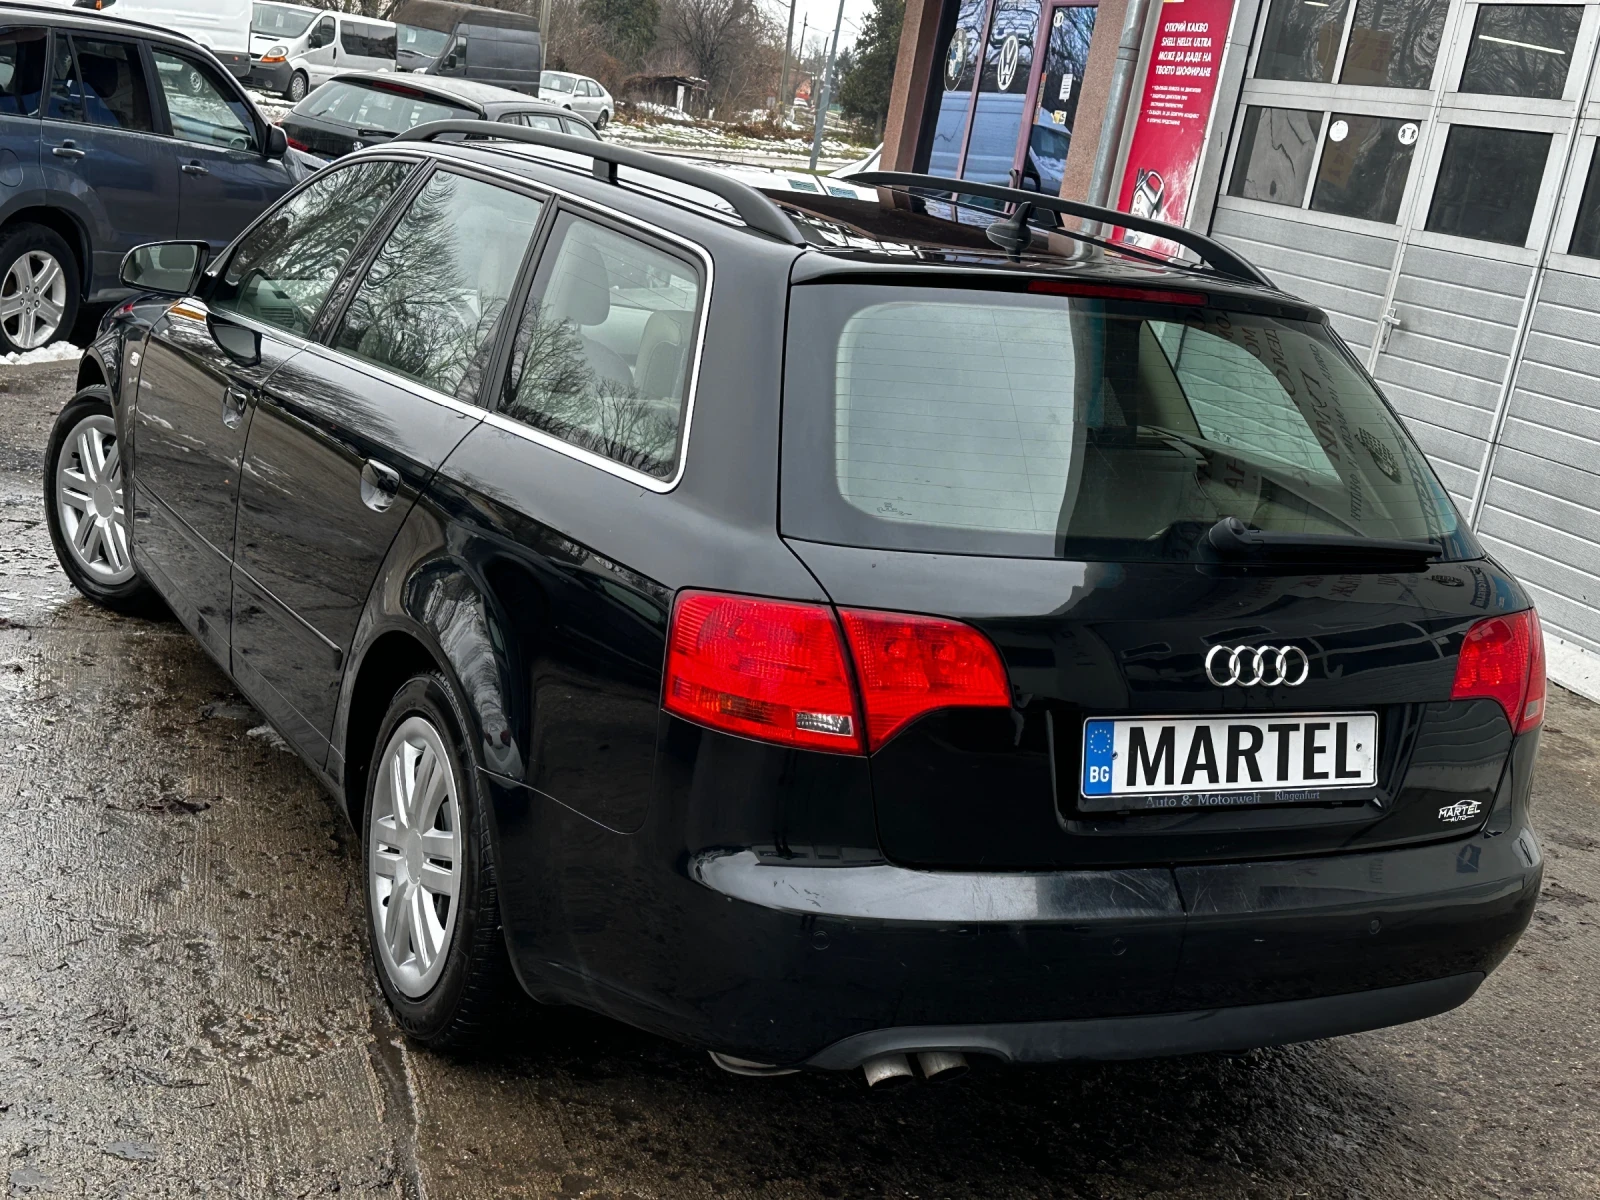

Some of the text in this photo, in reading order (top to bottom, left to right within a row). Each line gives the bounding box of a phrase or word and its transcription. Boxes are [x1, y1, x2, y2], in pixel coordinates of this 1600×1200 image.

[1165, 20, 1209, 32] ОТКРИЙ КАКВО
[1161, 37, 1211, 47] SHELL HELIX ULTRA
[1158, 51, 1211, 63] МОЖЕ ДА ДАДЕ НА
[1156, 65, 1211, 77] ТВОЕТО ШОФИРАНЕ
[1089, 722, 1361, 787] BG MARTEL
[1145, 790, 1320, 808] Auto & Motorwelt Klagenfurt
[1438, 804, 1481, 819] MARTEL
